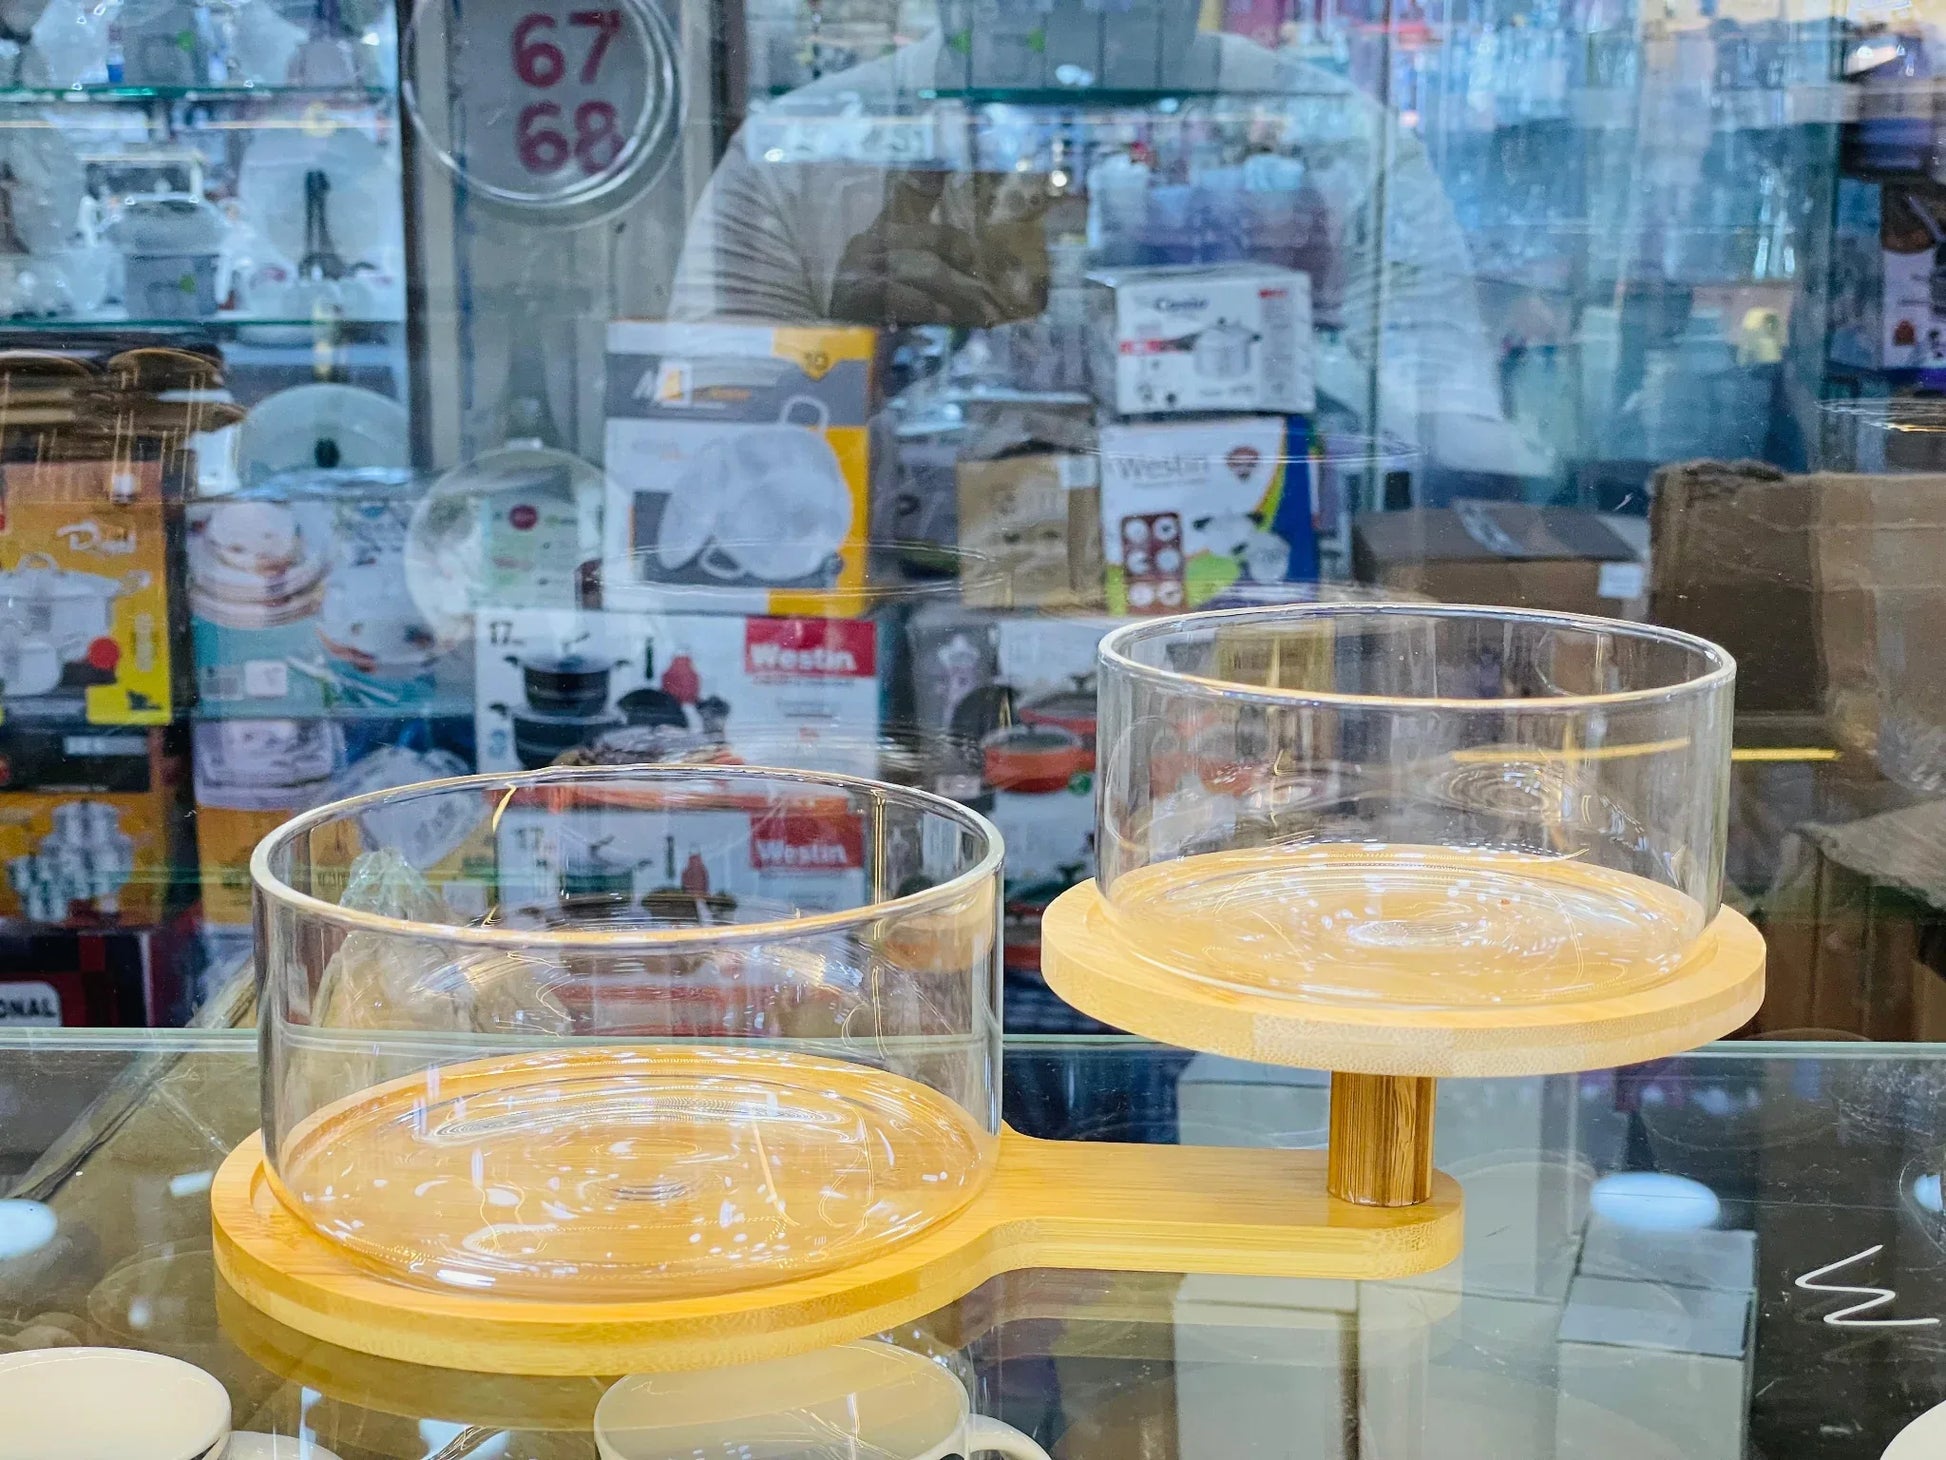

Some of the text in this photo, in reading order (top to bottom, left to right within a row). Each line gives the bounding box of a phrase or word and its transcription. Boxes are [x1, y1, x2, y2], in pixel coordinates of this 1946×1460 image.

[512, 9, 621, 90] 67
[516, 101, 625, 176] 68
[750, 643, 857, 671] Westin
